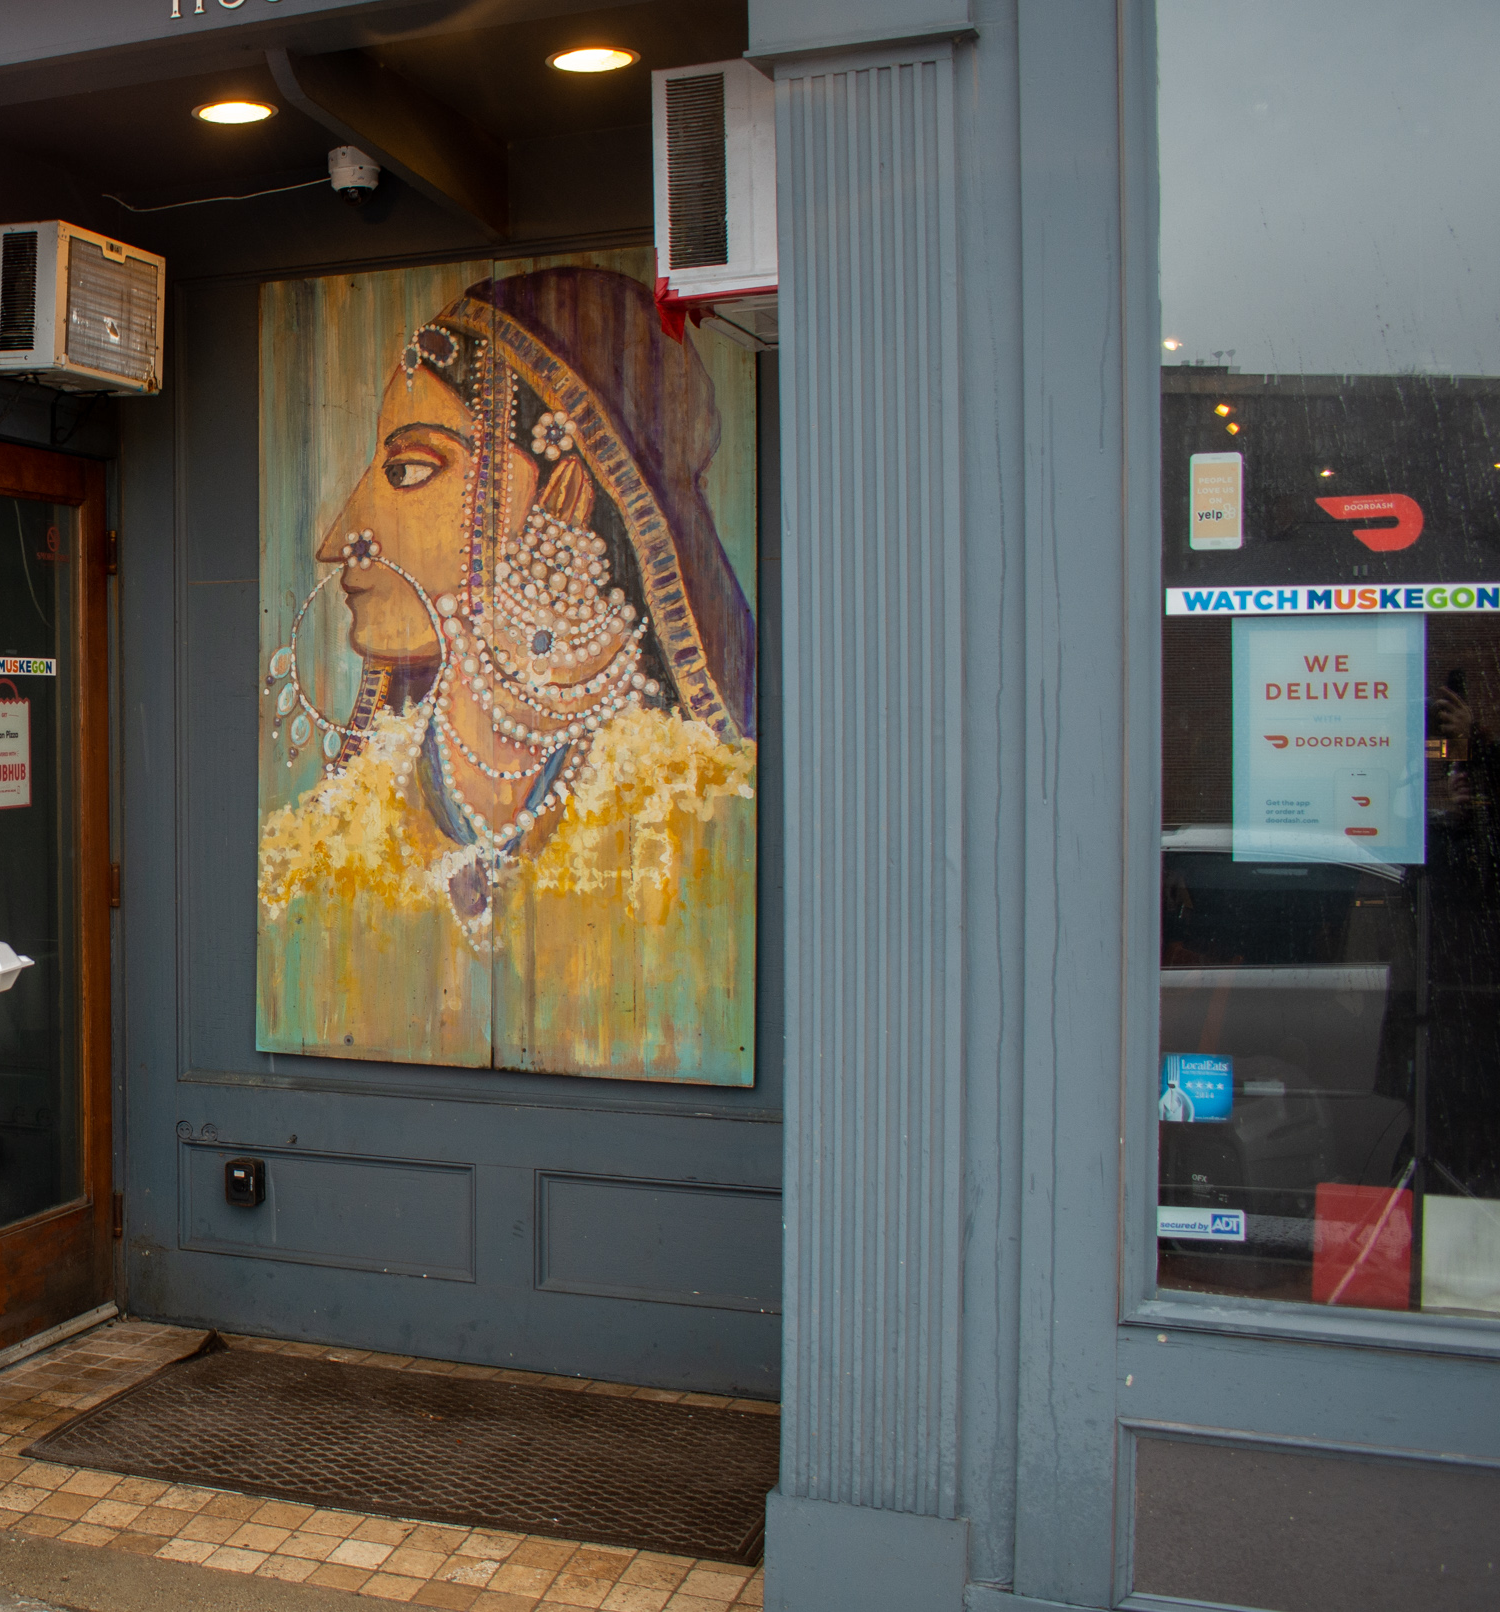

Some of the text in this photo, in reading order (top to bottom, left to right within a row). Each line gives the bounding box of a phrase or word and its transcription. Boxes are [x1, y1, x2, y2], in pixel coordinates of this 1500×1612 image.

[1198, 477, 1233, 485] PEOPLE
[1344, 503, 1393, 511] DOORDASH
[1197, 509, 1223, 522] yelp
[1182, 587, 1500, 611] WATCH MUSKEGON
[1304, 655, 1349, 672] WE
[1266, 682, 1389, 700] DELIVER
[1313, 715, 1342, 723] WITH
[6, 730, 19, 739] Pizza
[1295, 736, 1390, 747] DOORDASH
[1181, 1059, 1228, 1071] LocalEats
[1160, 1217, 1240, 1231] secured by ADT
